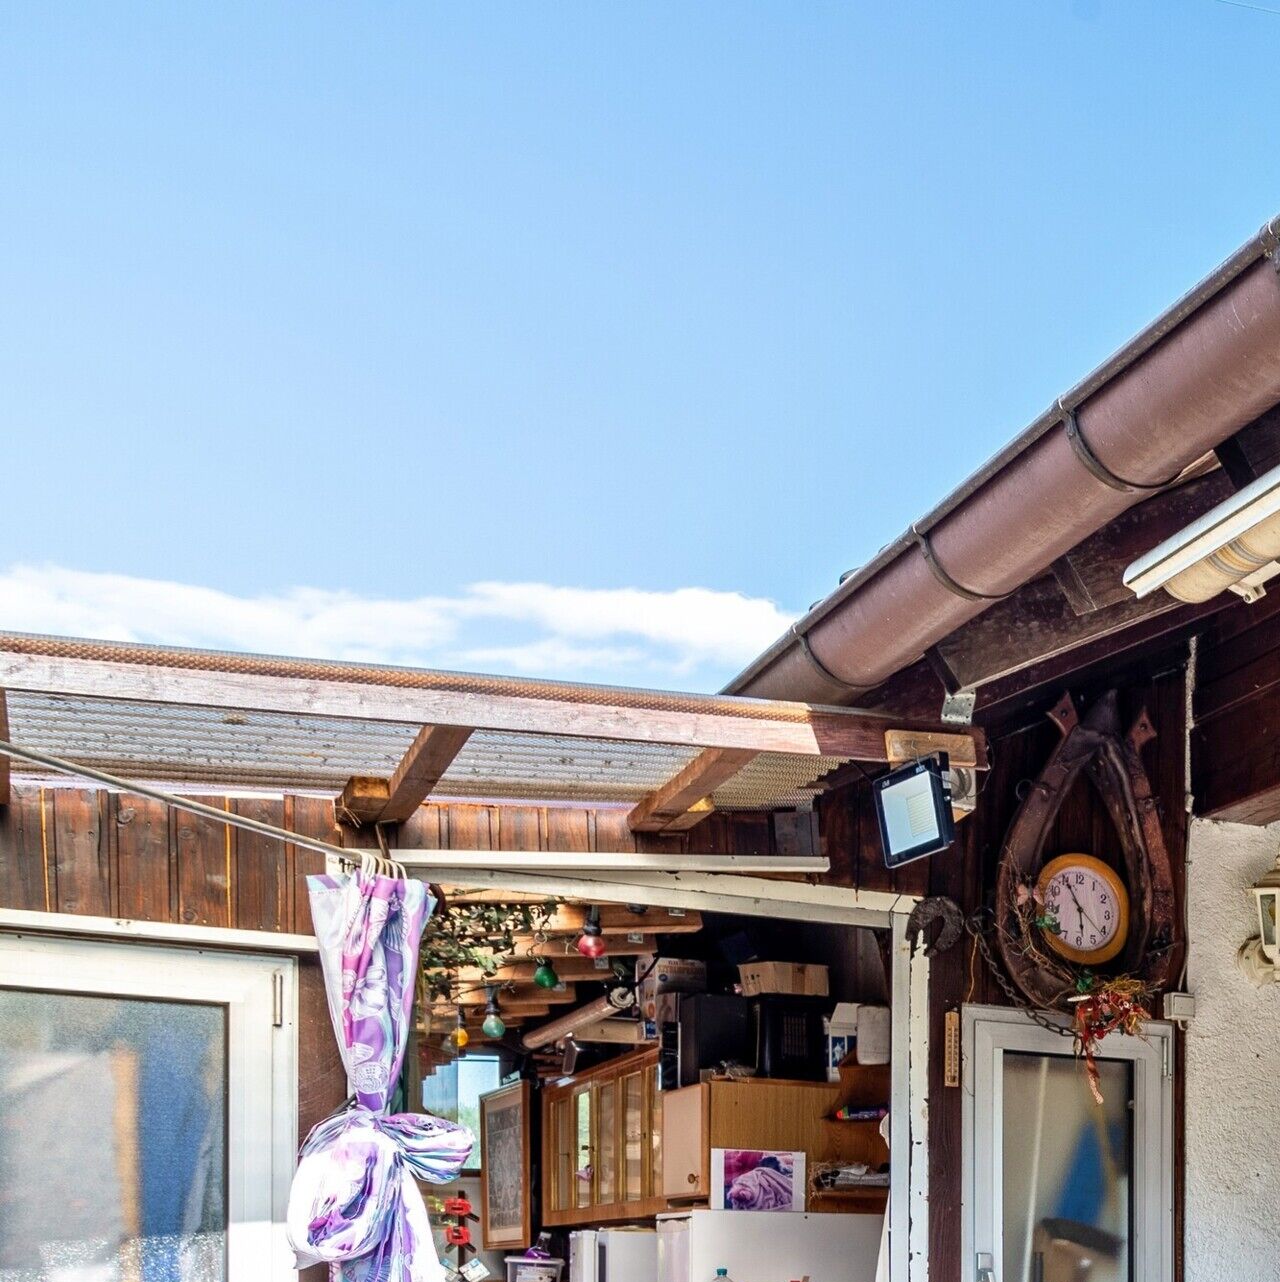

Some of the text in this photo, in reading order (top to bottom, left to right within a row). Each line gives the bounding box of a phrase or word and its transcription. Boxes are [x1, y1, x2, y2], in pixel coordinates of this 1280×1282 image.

[1075, 874, 1085, 885] 12
[1050, 884, 1061, 896] 10
[1092, 881, 1096, 891] 1
[1100, 894, 1107, 904] 2
[1104, 910, 1110, 921] 3
[1061, 930, 1068, 940] 7
[1100, 925, 1106, 935] 4
[1075, 936, 1082, 946] 6
[1090, 934, 1096, 945] 5
